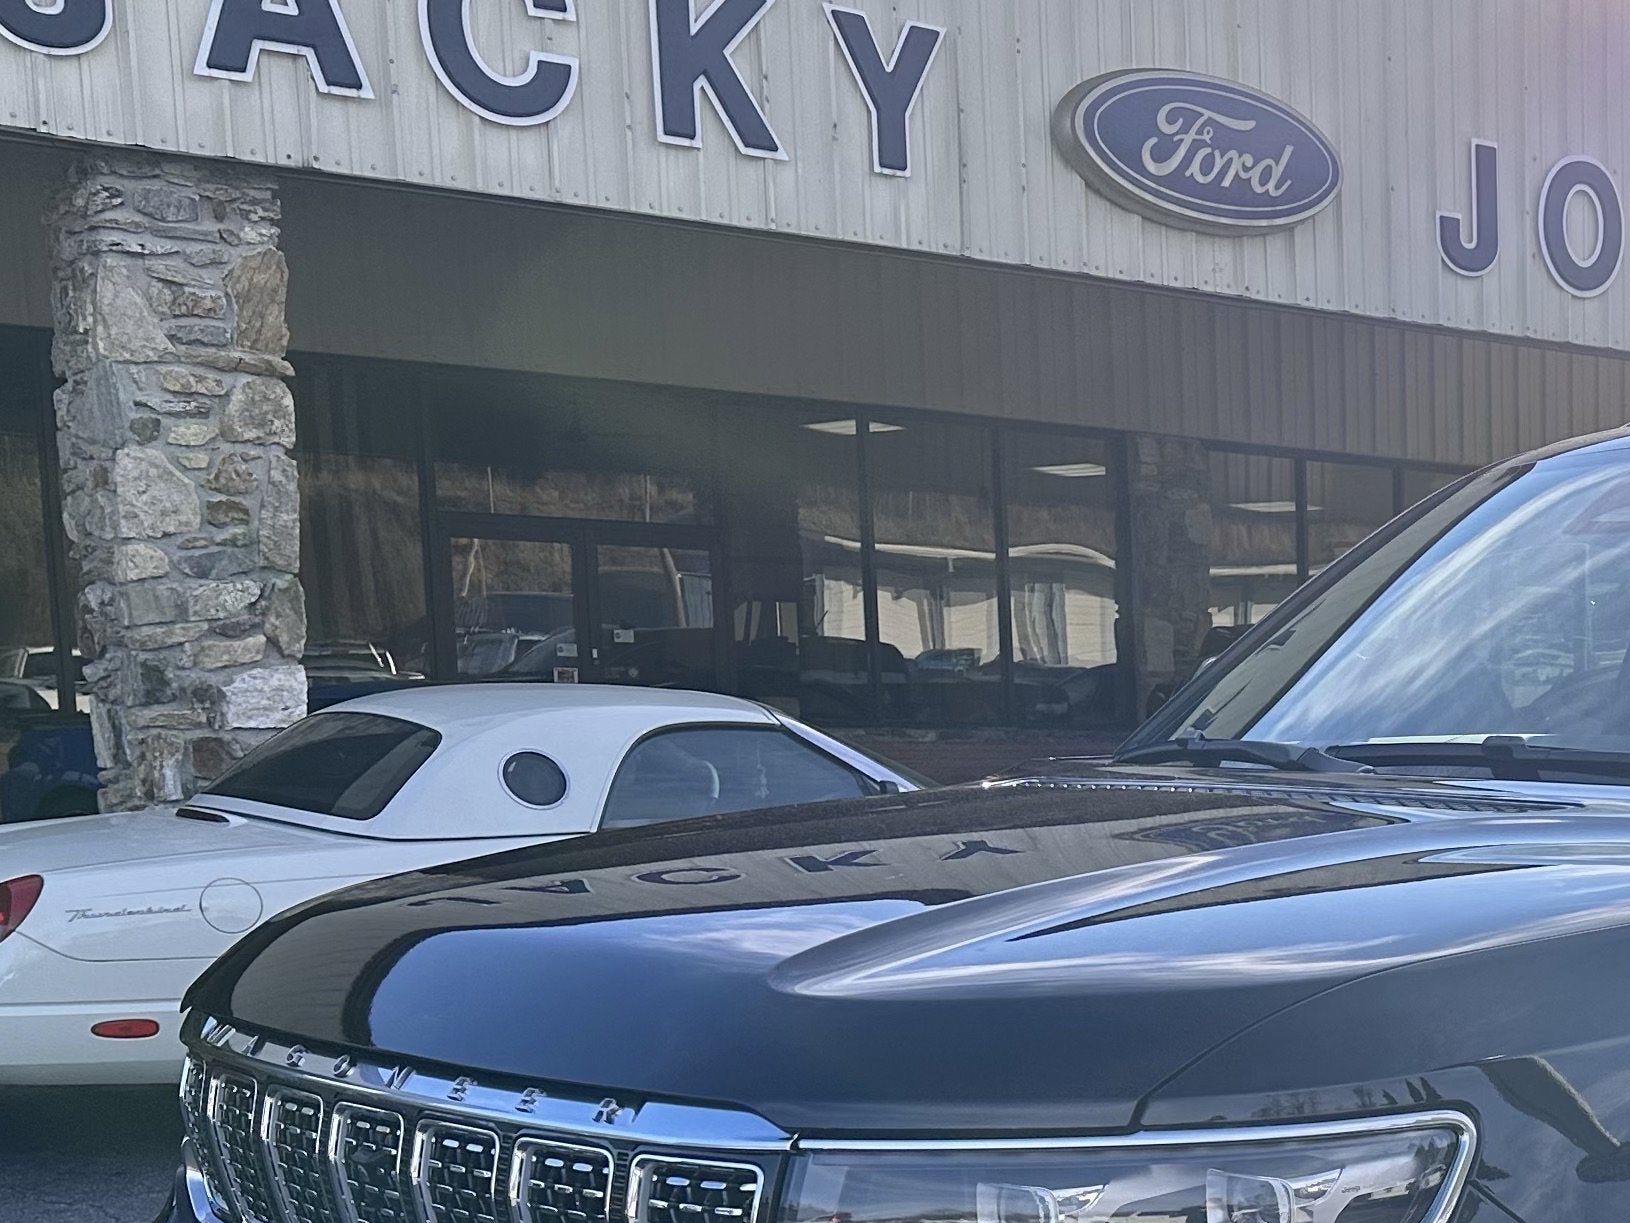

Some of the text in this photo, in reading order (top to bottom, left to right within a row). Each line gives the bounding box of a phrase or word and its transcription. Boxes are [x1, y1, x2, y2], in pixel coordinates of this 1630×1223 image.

[0, 0, 945, 177] ACKY
[1141, 102, 1294, 197] Ford
[65, 903, 192, 923] Thunderbird
